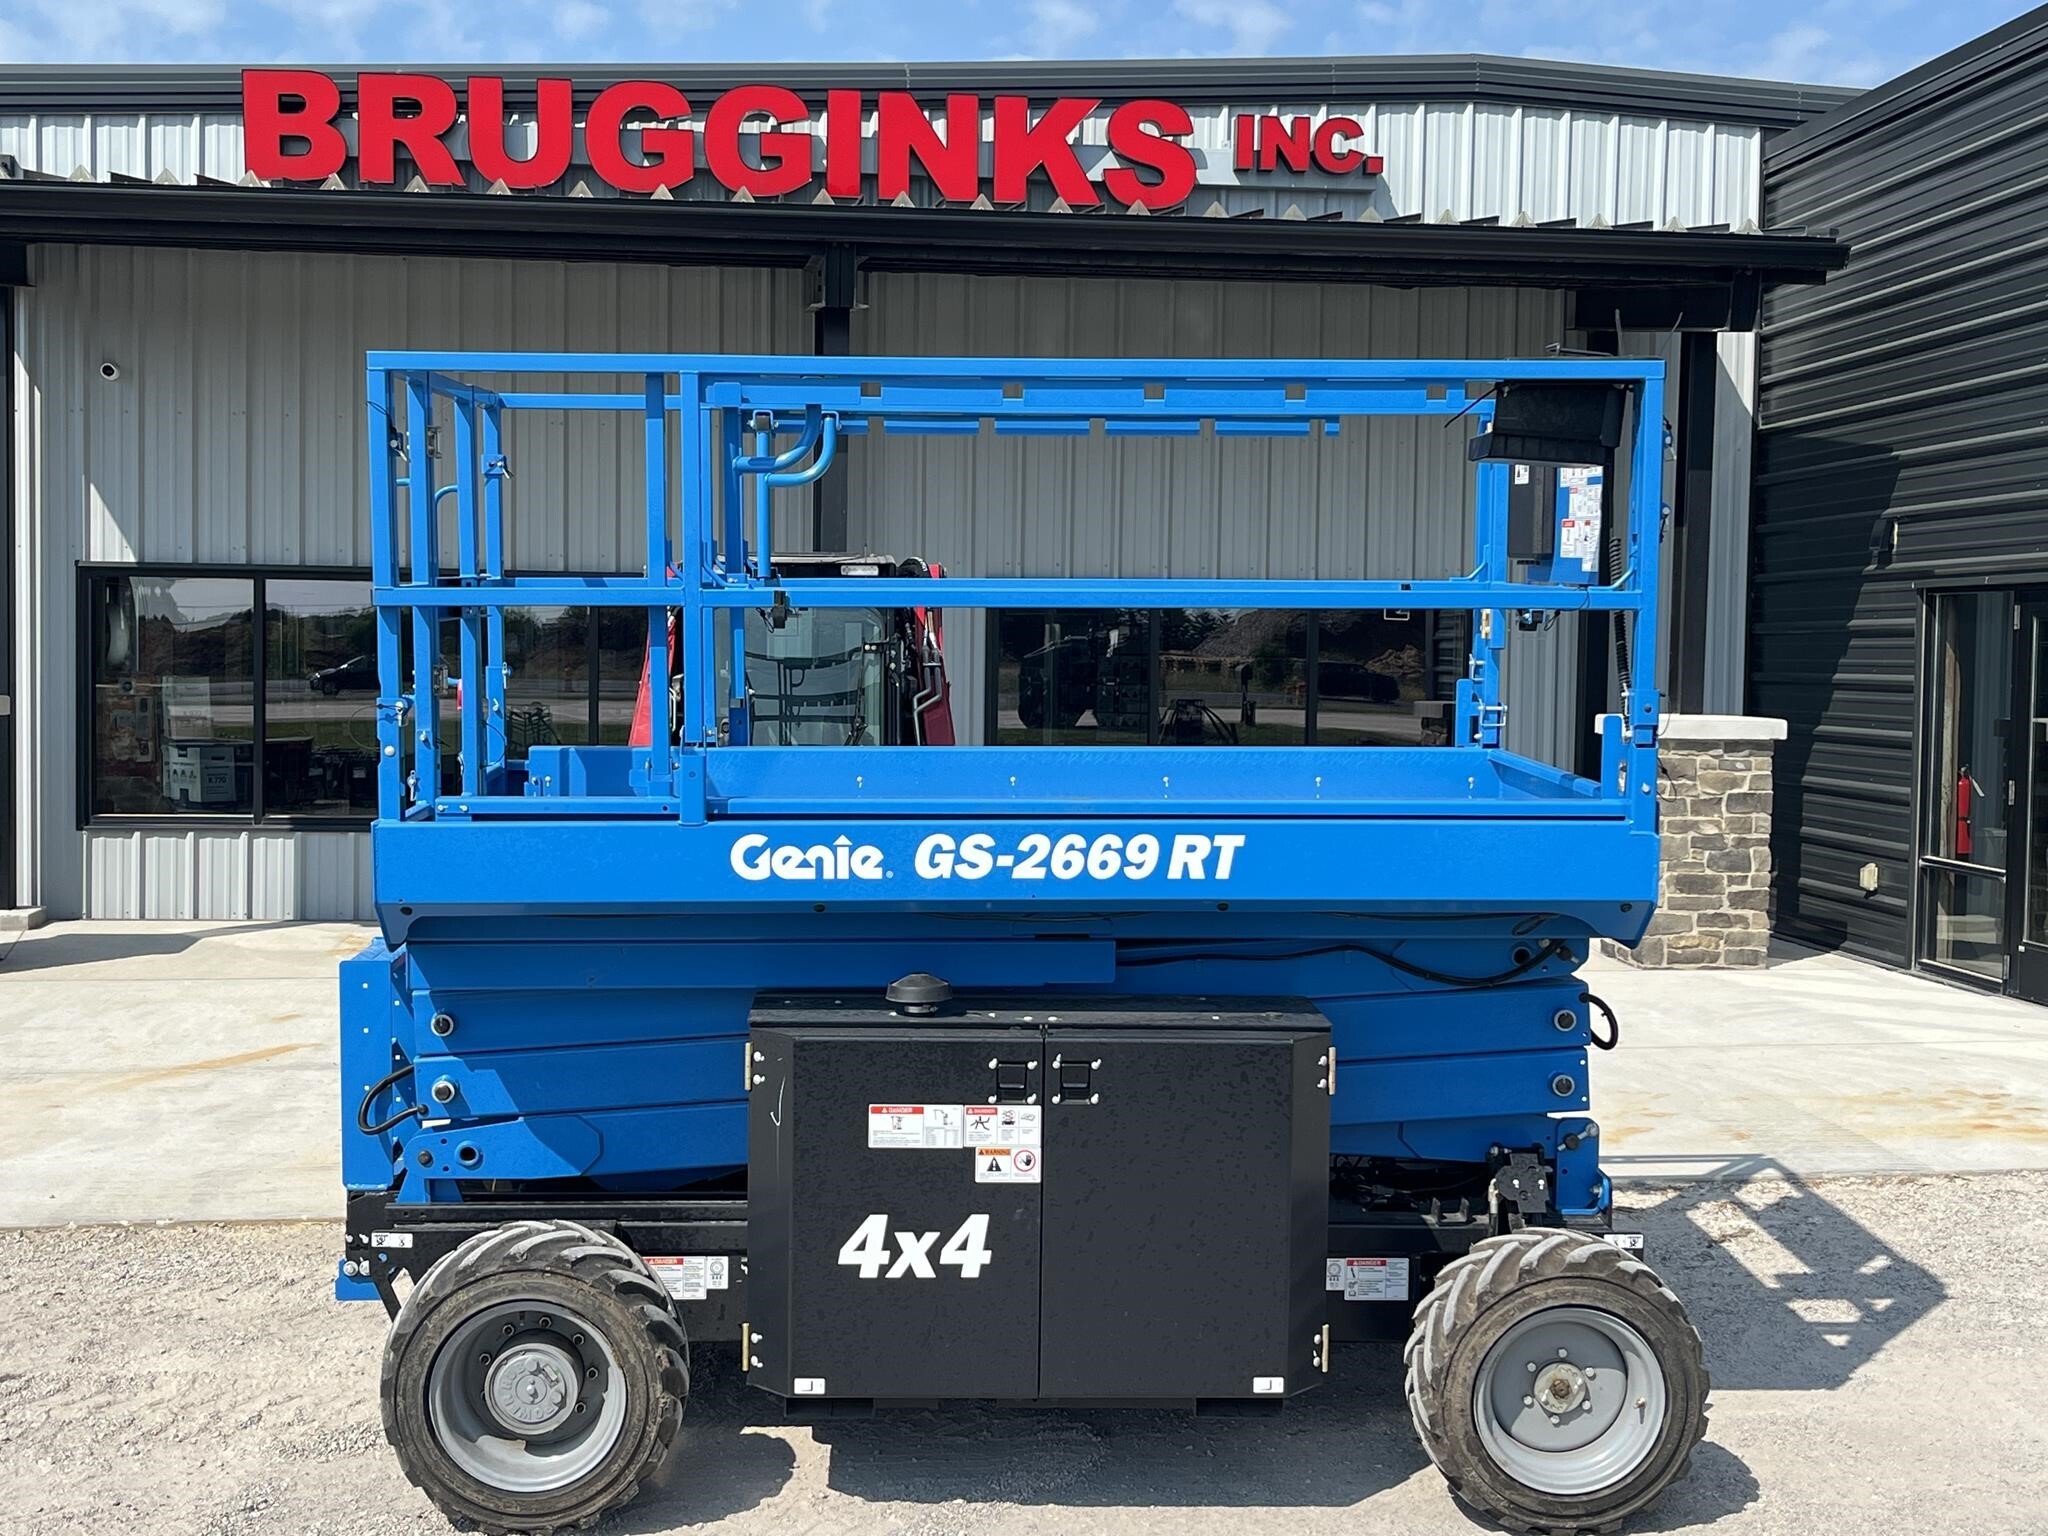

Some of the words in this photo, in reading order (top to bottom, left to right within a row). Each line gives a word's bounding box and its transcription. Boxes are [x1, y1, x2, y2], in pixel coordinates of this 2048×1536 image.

[242, 69, 1198, 209] BRUGGINKS
[1236, 114, 1383, 173] INC.
[730, 833, 884, 881] Genie
[914, 833, 1160, 880] GS-2669
[1167, 834, 1246, 880] RT
[837, 1213, 993, 1279] 4x4
